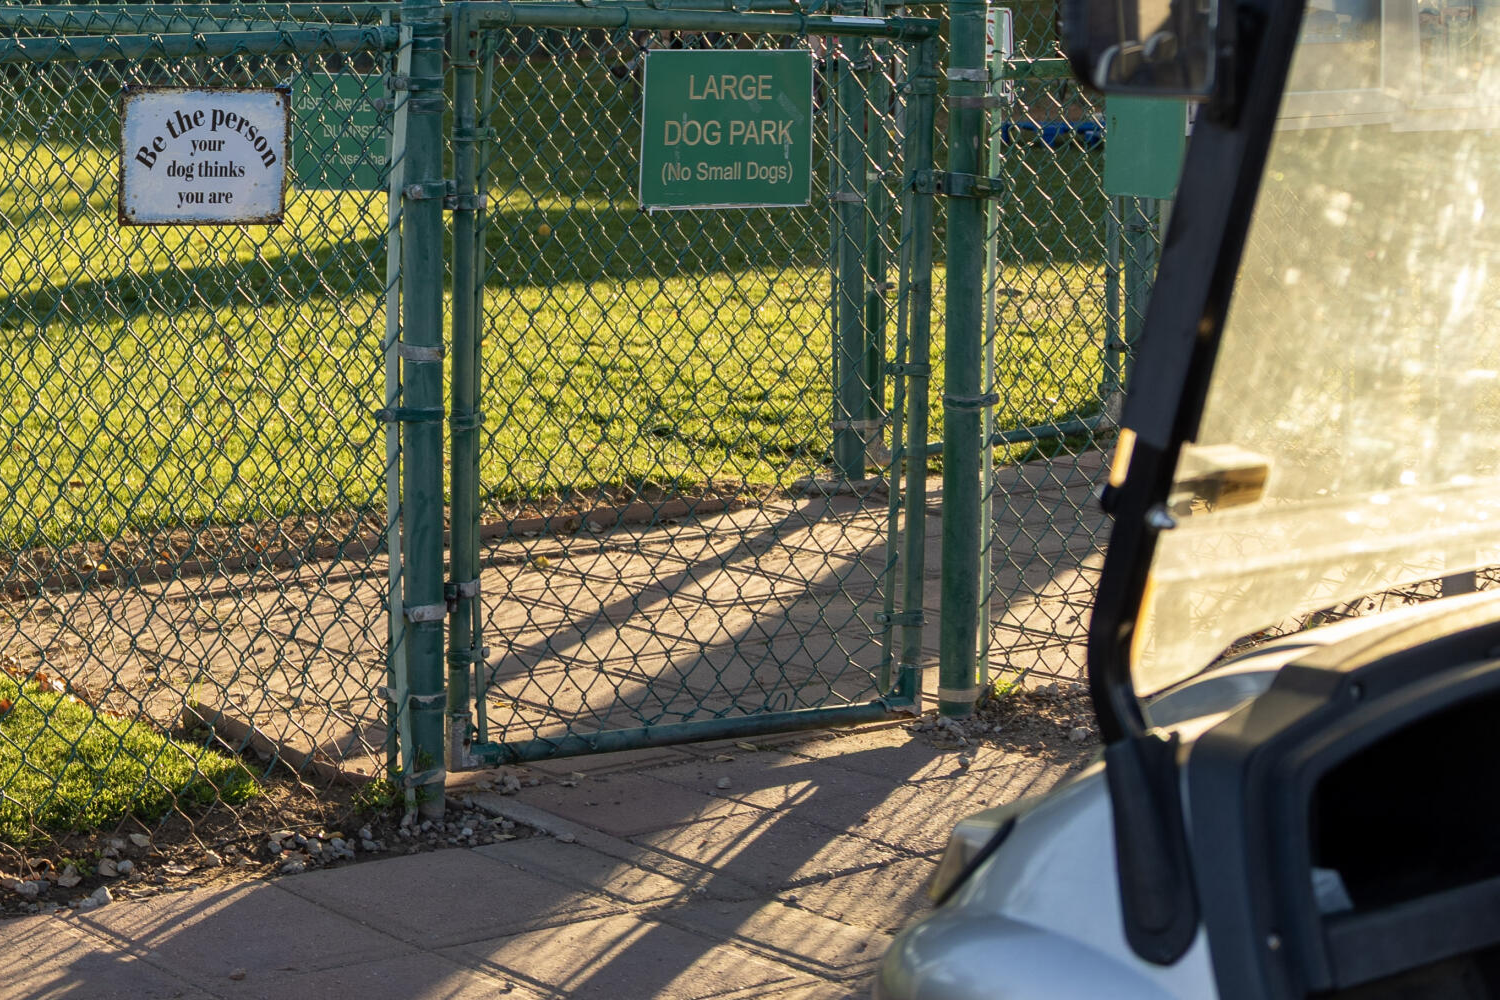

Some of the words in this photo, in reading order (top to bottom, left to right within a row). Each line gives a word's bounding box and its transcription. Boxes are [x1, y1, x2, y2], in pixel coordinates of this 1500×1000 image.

[689, 75, 773, 100] LARGE
[135, 136, 167, 171] Be
[166, 109, 206, 139] the
[210, 109, 277, 169] person
[323, 124, 386, 139] DUMPSTE
[664, 120, 722, 146] DOG
[729, 120, 795, 146] PARK
[190, 139, 226, 157] your
[167, 160, 195, 182] dog
[198, 161, 246, 178] thinks
[661, 162, 692, 186] (No
[696, 161, 742, 181] Small
[746, 161, 794, 185] Dogs)
[177, 191, 204, 208] you
[208, 191, 234, 204] are
